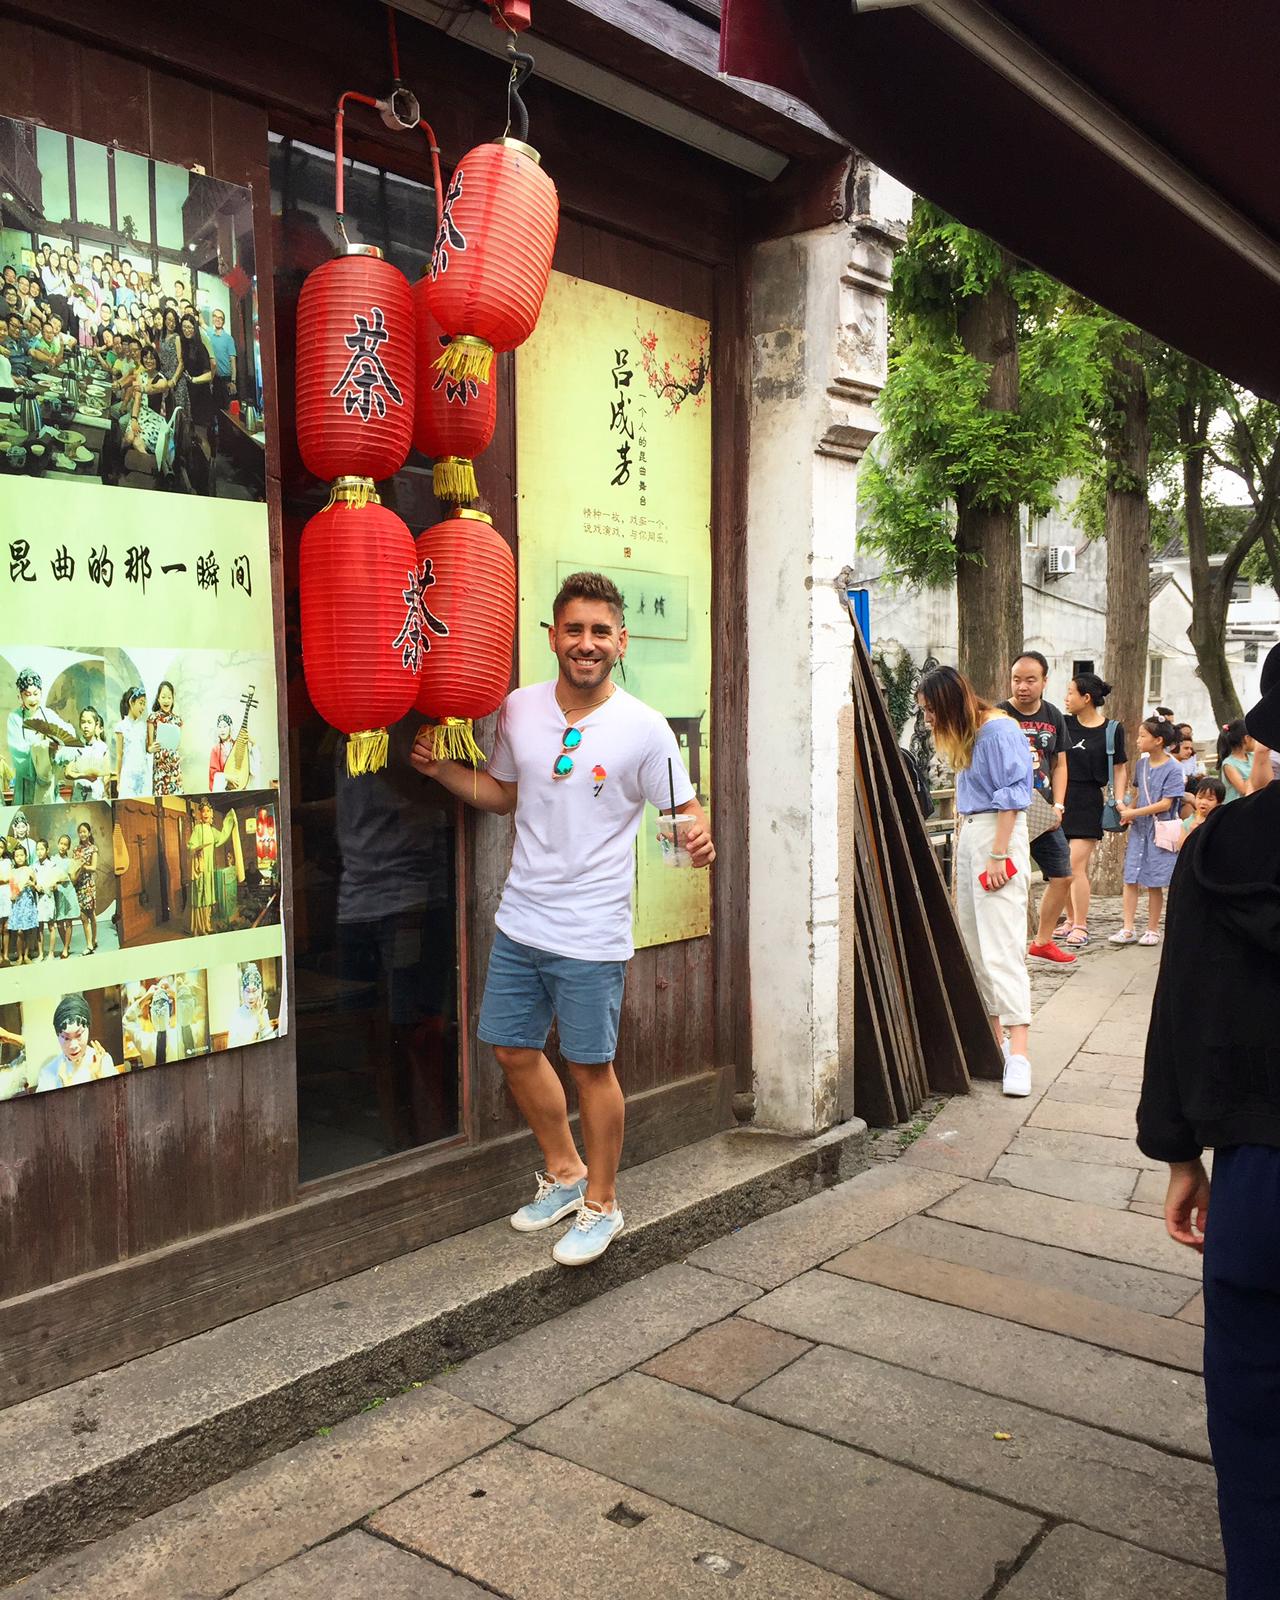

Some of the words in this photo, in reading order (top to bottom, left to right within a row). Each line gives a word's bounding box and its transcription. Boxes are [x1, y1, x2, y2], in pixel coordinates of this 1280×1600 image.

[330, 307, 403, 422] 茶
[8, 539, 252, 598] 昆曲的那一瞬间
